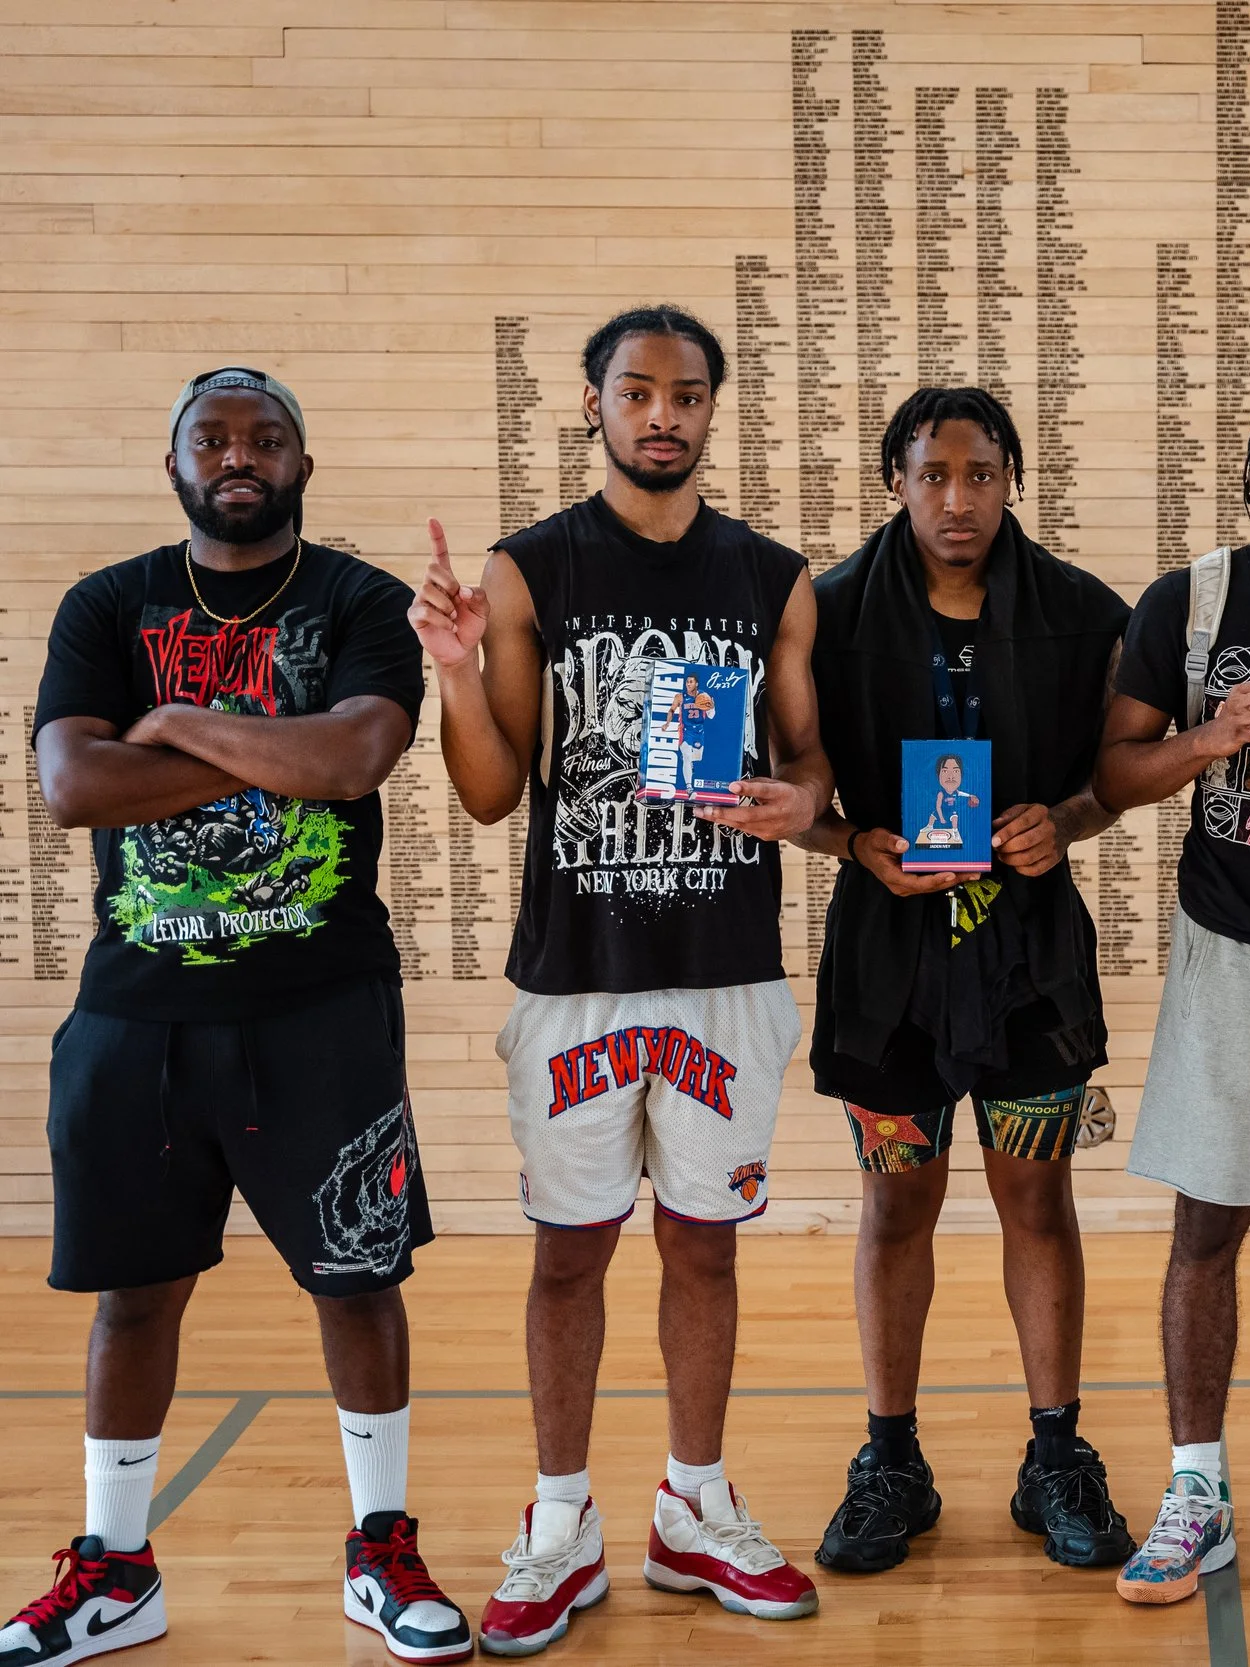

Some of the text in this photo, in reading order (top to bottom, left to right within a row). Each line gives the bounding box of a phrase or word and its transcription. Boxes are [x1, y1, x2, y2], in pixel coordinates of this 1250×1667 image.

[566, 615, 758, 636] NITED STATES
[644, 661, 685, 799] JADEN IVEY
[563, 754, 611, 776] Fitness
[552, 792, 760, 870] HLET
[576, 868, 728, 894] NEW YORK CITY
[152, 903, 312, 943] LETHAL PROTECTOR
[548, 1026, 737, 1121] NEW YORK
[992, 1100, 1059, 1115] Hollywood
[730, 1160, 767, 1184] KNICKS
